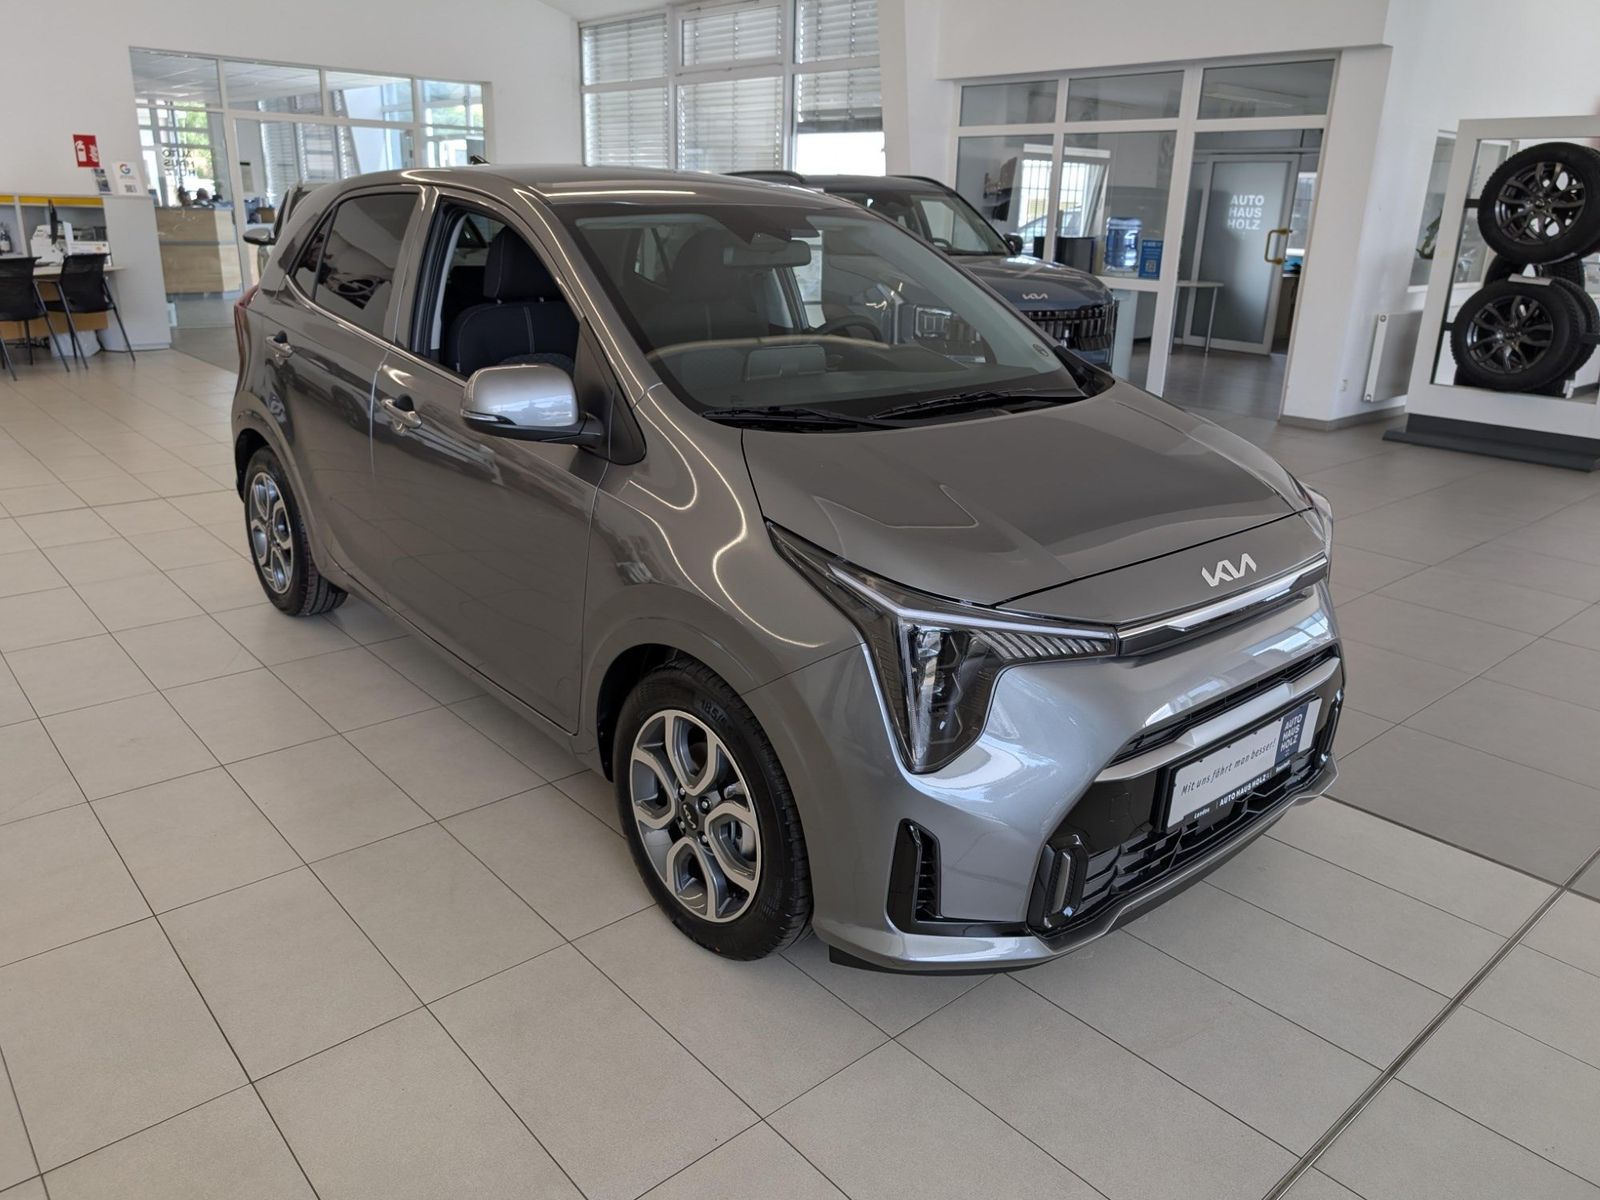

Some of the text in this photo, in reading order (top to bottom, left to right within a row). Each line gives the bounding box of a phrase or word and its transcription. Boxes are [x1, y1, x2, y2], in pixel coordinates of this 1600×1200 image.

[1230, 195, 1265, 206] AUTO
[1229, 207, 1262, 218] HAUS
[1227, 219, 1261, 230] HOLZ
[1201, 553, 1257, 587] KIA
[1284, 713, 1303, 731] AUTO
[1282, 724, 1300, 741] HAUS
[1280, 734, 1298, 752] HOLZ
[1181, 782, 1195, 796] Mit
[1196, 775, 1211, 788] uns
[1234, 754, 1250, 768] man
